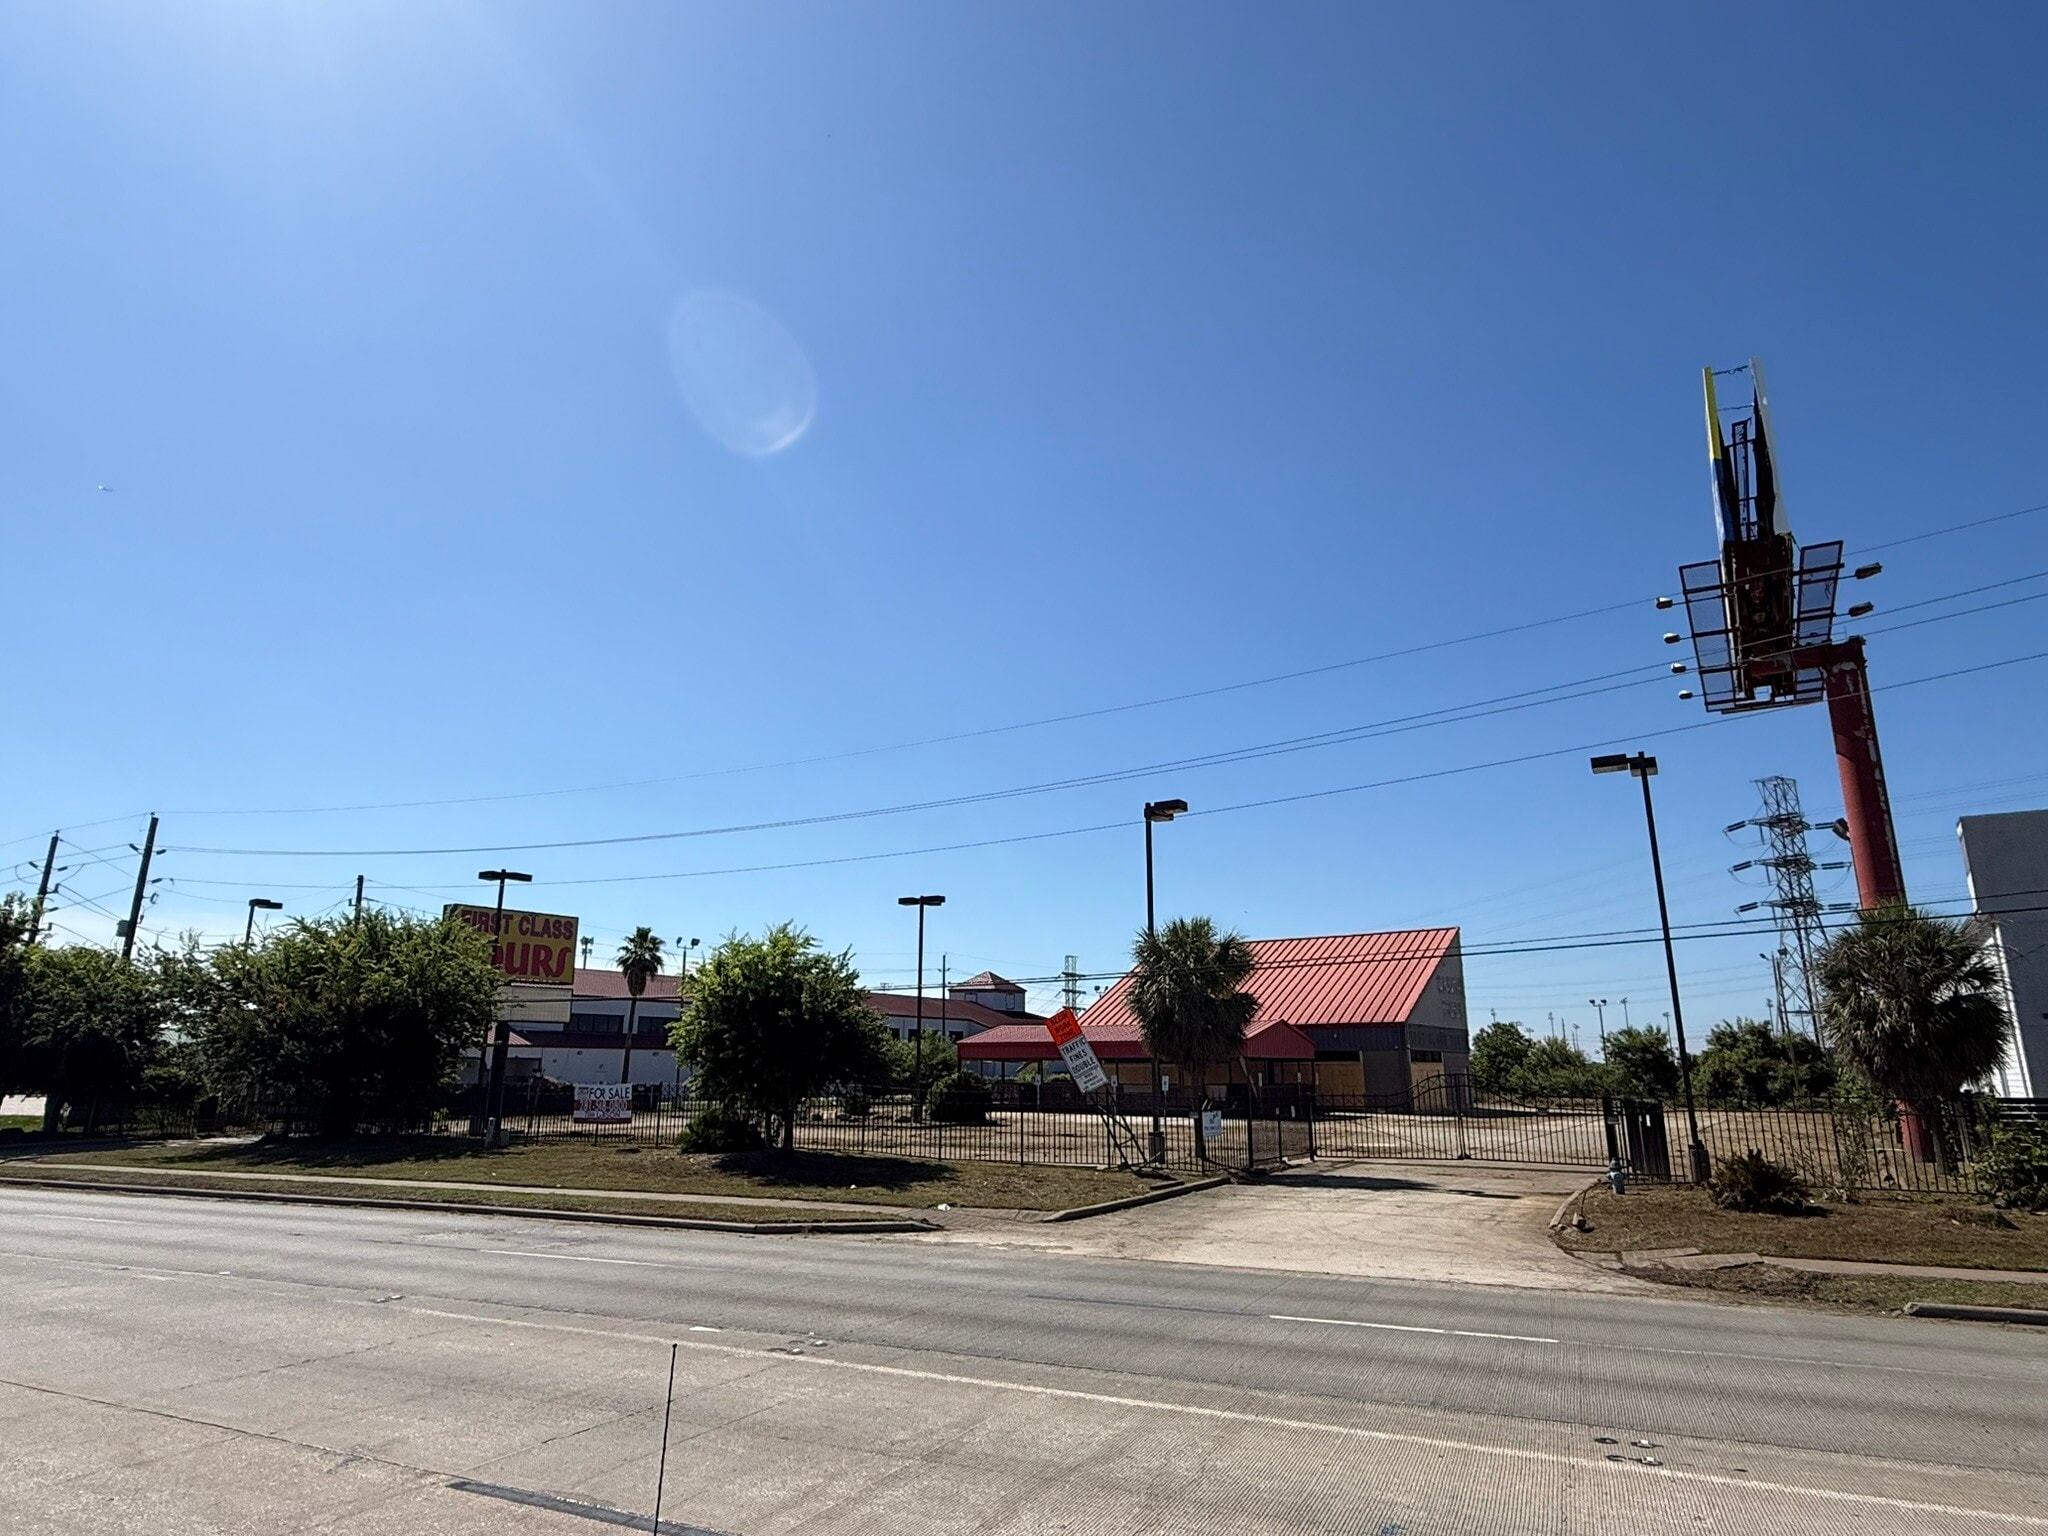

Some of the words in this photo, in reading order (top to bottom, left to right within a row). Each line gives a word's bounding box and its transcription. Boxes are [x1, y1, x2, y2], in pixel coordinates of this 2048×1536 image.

[518, 915, 573, 940] CLASS
[1061, 1037, 1086, 1055] TRAFFIC
[1069, 1048, 1088, 1063] FINES
[1071, 1056, 1096, 1075] DOUBLE
[588, 1087, 606, 1100] FOR
[608, 1086, 630, 1100] SALE
